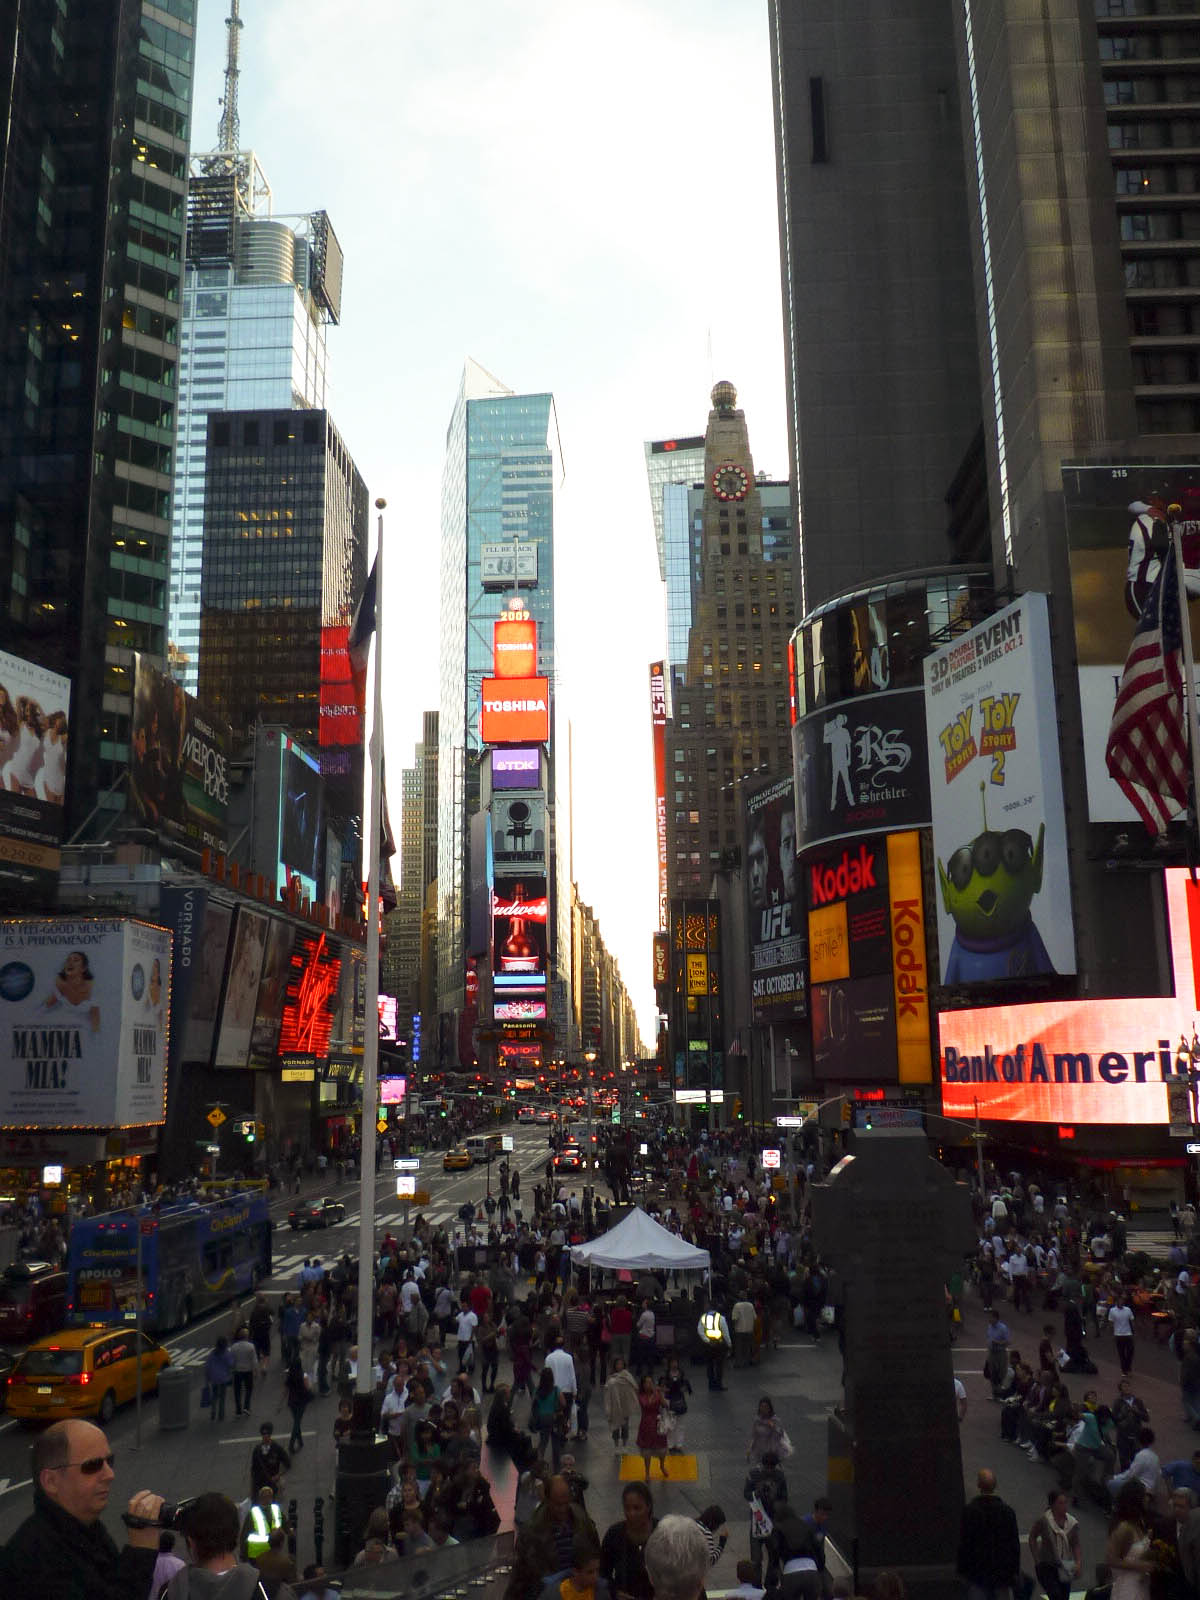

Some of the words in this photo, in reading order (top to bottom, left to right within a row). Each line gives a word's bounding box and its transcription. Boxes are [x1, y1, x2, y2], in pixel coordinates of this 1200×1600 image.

[500, 611, 530, 621] 2009
[931, 656, 949, 683] 3D
[975, 609, 1021, 657] EVENT
[483, 700, 547, 712] TOSHIBA
[939, 703, 974, 760] TOY
[979, 692, 1021, 736] TOY
[983, 734, 1013, 748] STORY
[182, 731, 226, 778] MELROSE
[991, 749, 1006, 786] 2
[203, 770, 229, 806] PLACE
[811, 844, 876, 905] Kodak
[182, 890, 195, 968] VORNADO
[761, 902, 792, 942] UFC
[689, 968, 705, 978] LION
[893, 899, 926, 1018] Kodak
[689, 980, 706, 989] KING
[766, 972, 795, 995] OCTOBER
[795, 969, 805, 990] 24
[12, 1030, 82, 1059] MAMMA
[25, 1060, 67, 1089] MIA!
[944, 1044, 1000, 1083] Bank
[1001, 1043, 1027, 1083] of
